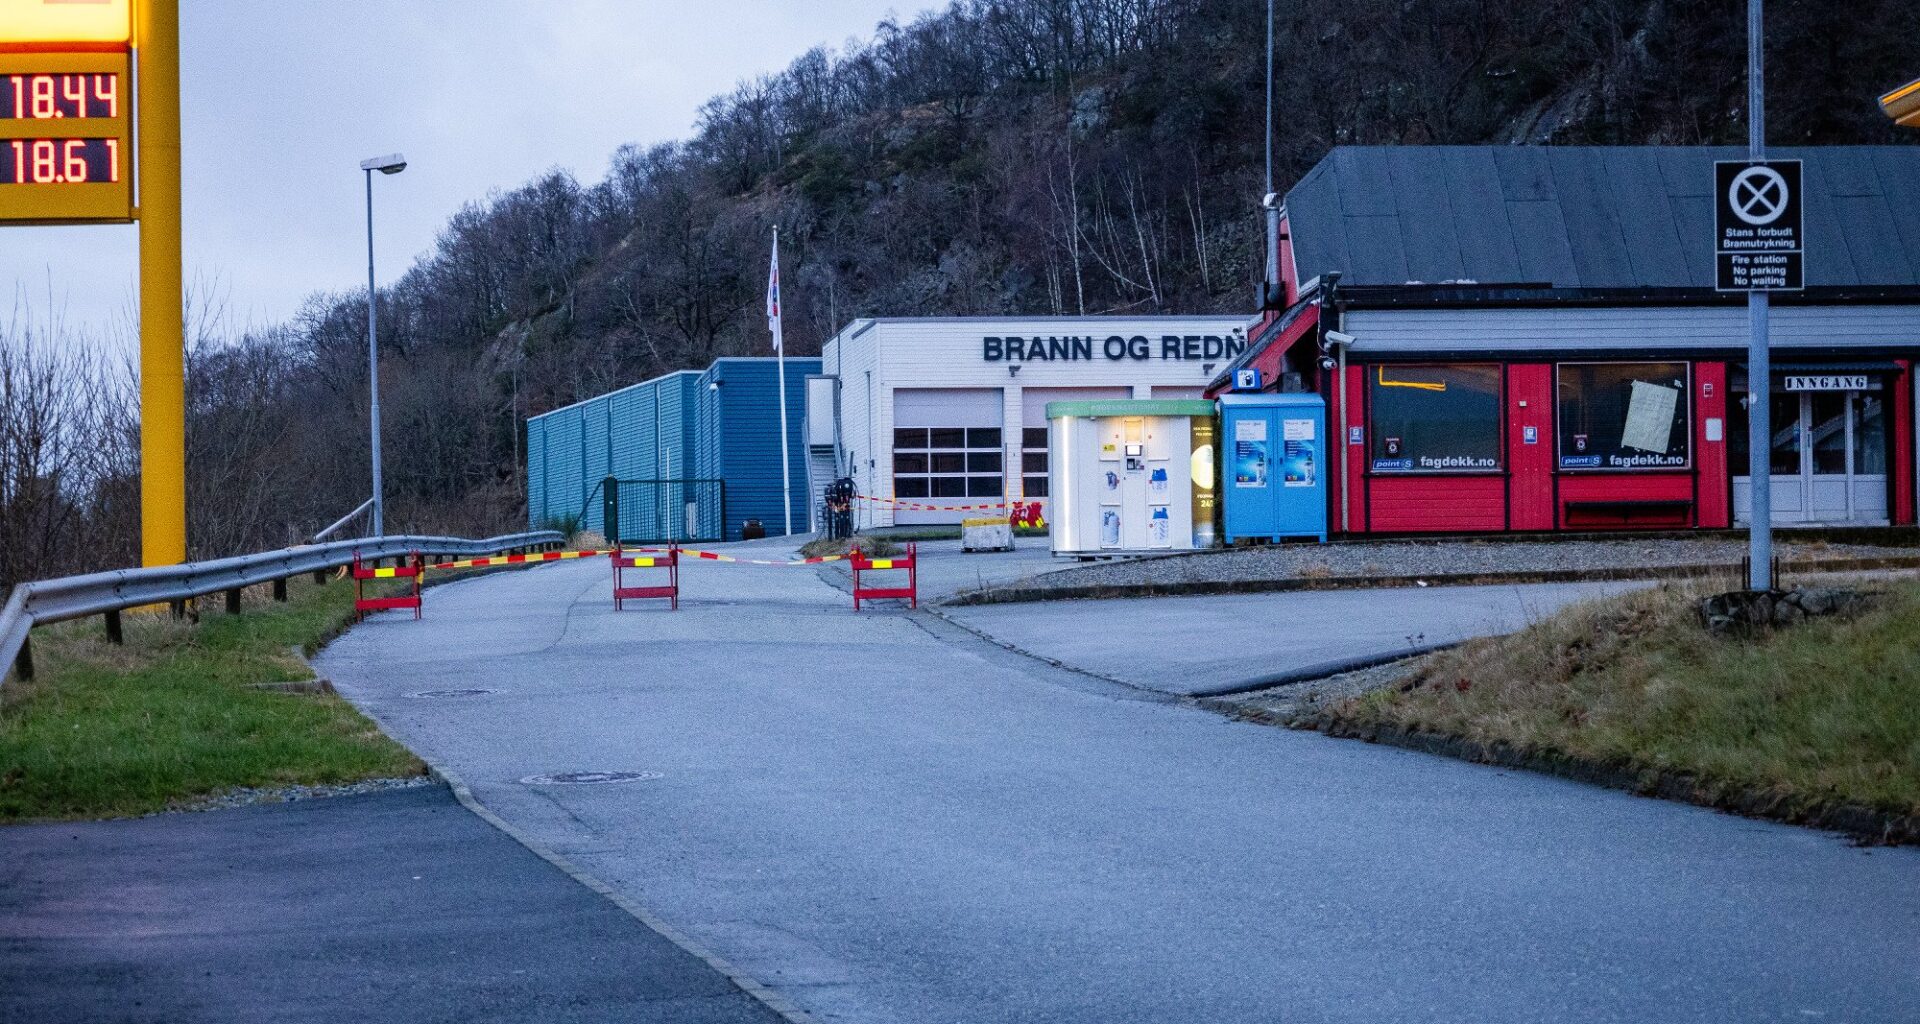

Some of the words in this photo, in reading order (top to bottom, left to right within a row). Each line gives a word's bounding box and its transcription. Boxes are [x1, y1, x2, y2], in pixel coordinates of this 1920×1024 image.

[11, 75, 117, 119] 18.44
[11, 139, 118, 184] 18.61
[1726, 228, 1753, 237] Stans
[1758, 227, 1793, 237] forbudt
[1723, 239, 1795, 249] Brannutrykning
[1732, 255, 1750, 264] Fire
[1753, 255, 1787, 264] station
[1733, 267, 1747, 275] No
[1750, 266, 1786, 276] parking
[1734, 277, 1748, 285] No
[1751, 276, 1786, 286] waiting
[983, 336, 1092, 361] BRANN
[1103, 335, 1150, 360] OG
[1786, 377, 1864, 389] INNGANG
[1376, 460, 1400, 469] point
[1420, 456, 1496, 469] fagdekk.no
[1565, 456, 1588, 465] point
[1609, 454, 1684, 467] fagdekk.no
